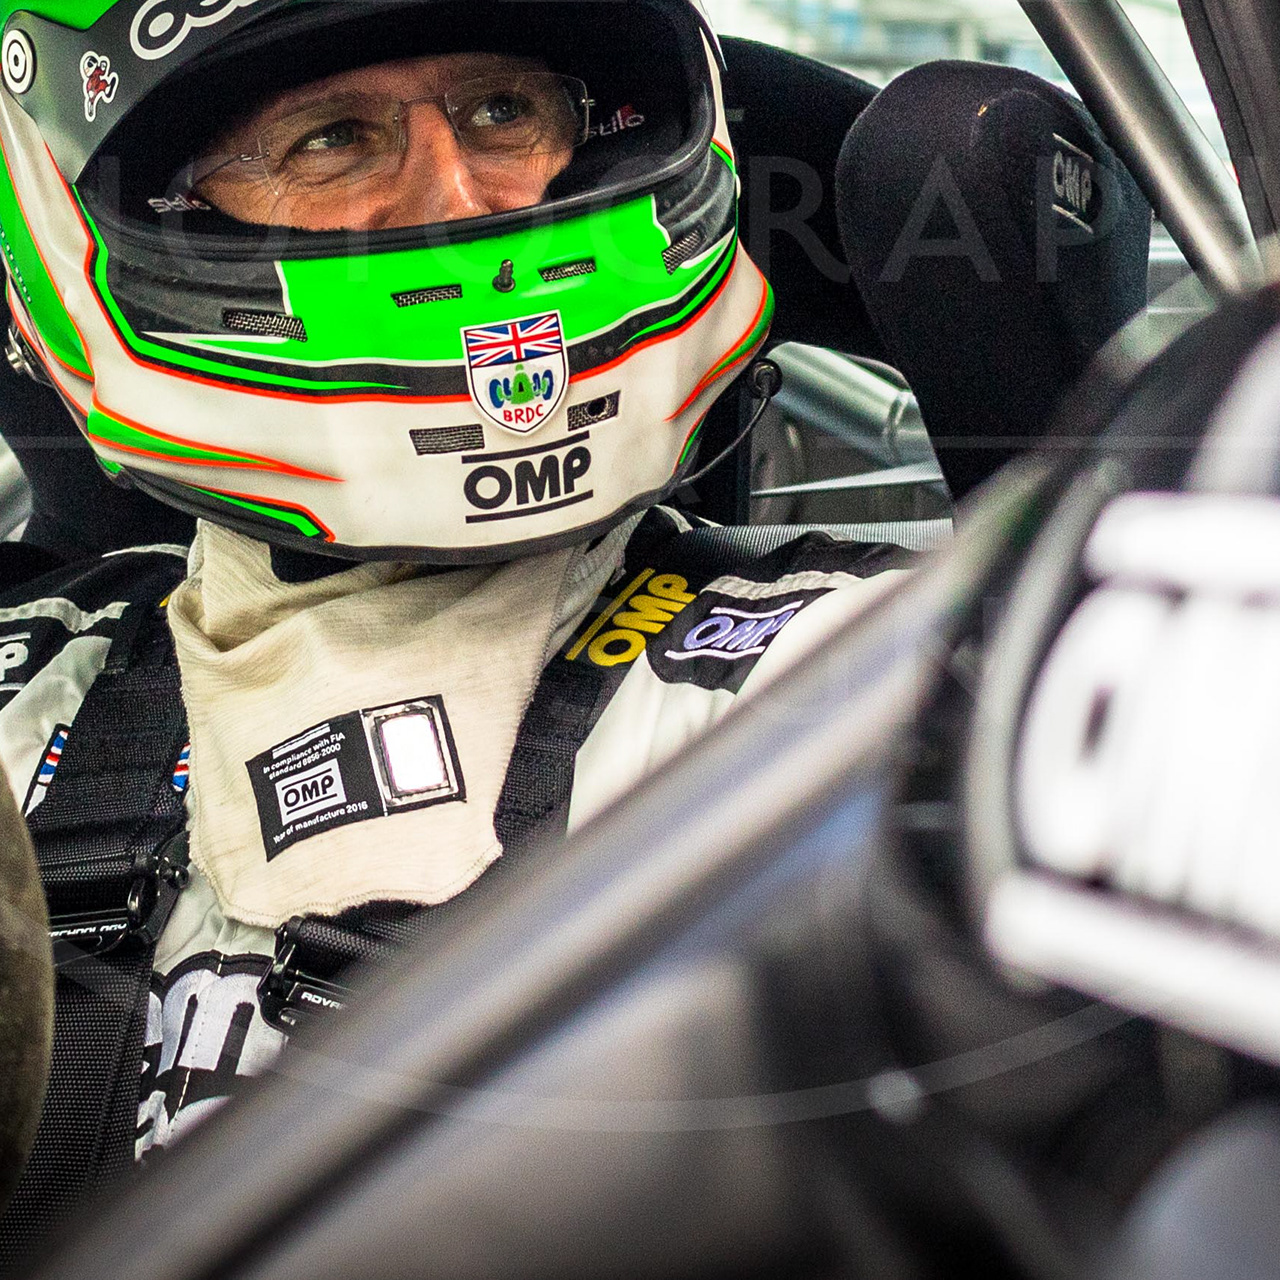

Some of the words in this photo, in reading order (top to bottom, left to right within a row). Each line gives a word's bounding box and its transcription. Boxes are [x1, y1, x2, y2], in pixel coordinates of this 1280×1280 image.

[1052, 151, 1092, 213] OMP
[503, 403, 544, 424] BRDC
[463, 446, 592, 510] OMP
[587, 573, 698, 667] OMP
[683, 609, 795, 651] OMP
[262, 766, 271, 774] In
[271, 747, 313, 771] compliance
[313, 738, 330, 751] with
[330, 732, 346, 744] FIA
[268, 760, 302, 780] standard
[283, 775, 335, 808] OMP
[273, 831, 286, 844] Year
[286, 825, 294, 836] of
[295, 808, 346, 832] manufacture
[346, 801, 369, 814] 2016
[301, 991, 345, 1010] ADVA
